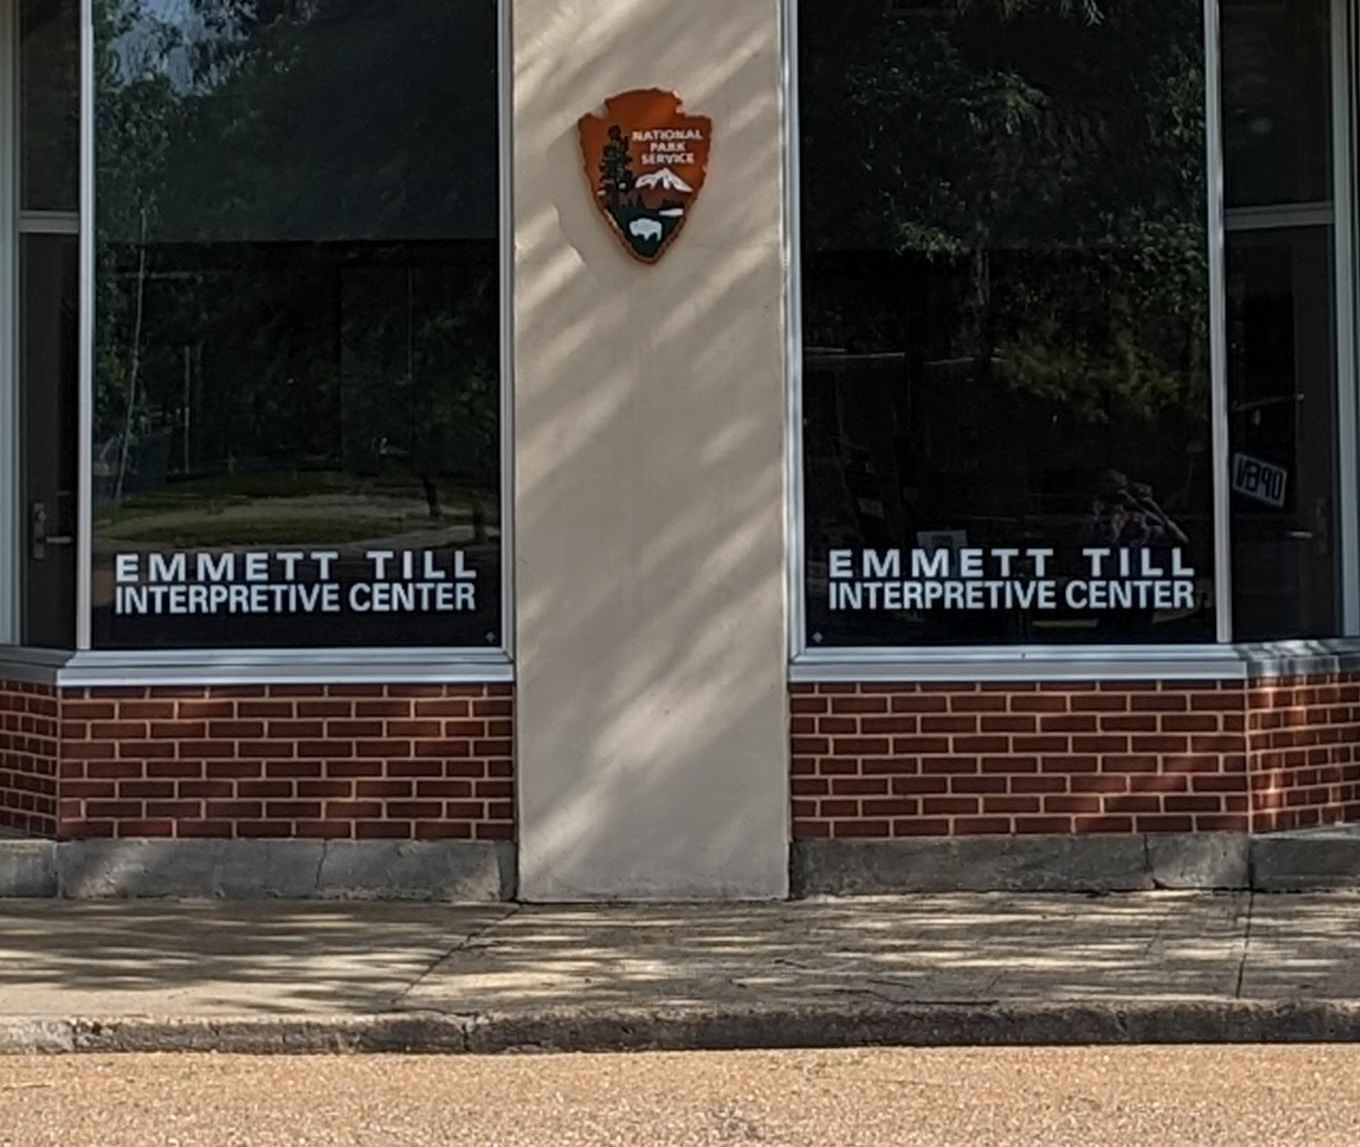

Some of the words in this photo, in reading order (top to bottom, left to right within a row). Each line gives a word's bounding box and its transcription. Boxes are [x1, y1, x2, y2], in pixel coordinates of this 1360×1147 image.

[632, 129, 703, 141] NATIONAL
[650, 142, 686, 152] PARK
[641, 152, 694, 165] SERVICE
[115, 552, 338, 582] EMMETT
[366, 551, 477, 580] TILL
[829, 548, 1054, 578] EMMETT
[1083, 547, 1194, 577] TILL
[115, 584, 340, 614] INTERPRETIVE
[349, 582, 476, 612] CENTER
[829, 580, 1056, 610] INTERPRETIVE
[1065, 580, 1194, 609] CENTER
